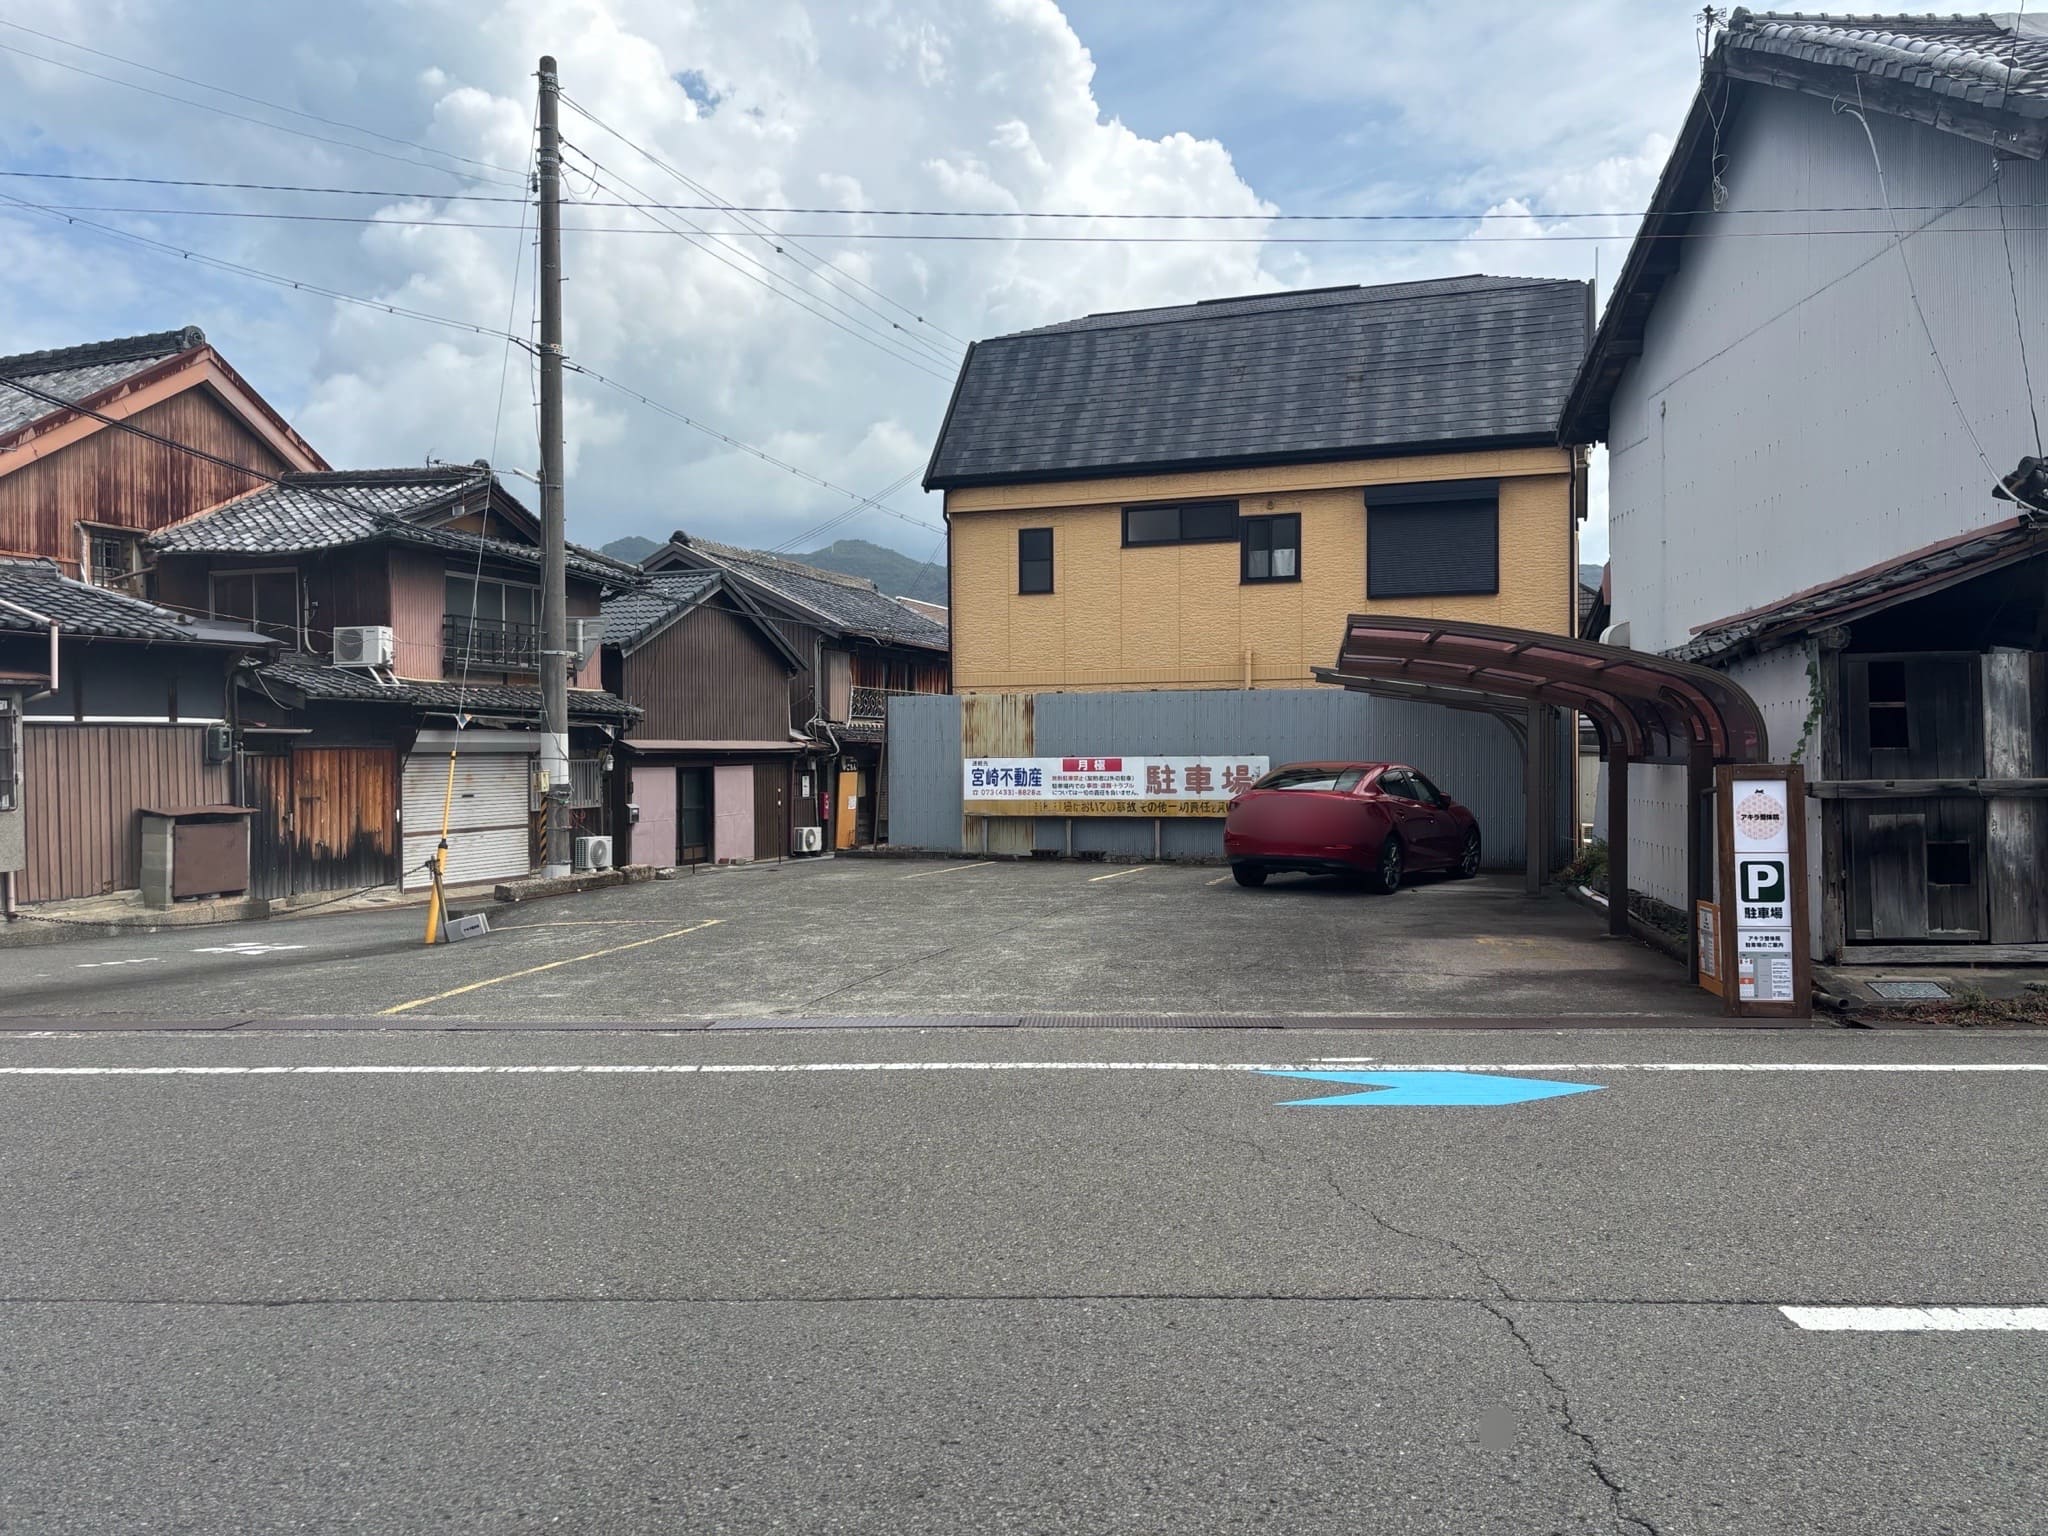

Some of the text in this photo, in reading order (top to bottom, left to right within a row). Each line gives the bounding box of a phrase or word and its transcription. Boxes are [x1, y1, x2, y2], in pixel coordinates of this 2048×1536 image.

[972, 768, 1042, 787] 宮崎不動産
[1145, 764, 1253, 795] 駐車場
[1747, 864, 1778, 899] P
[1744, 907, 1783, 919] 駐車場
